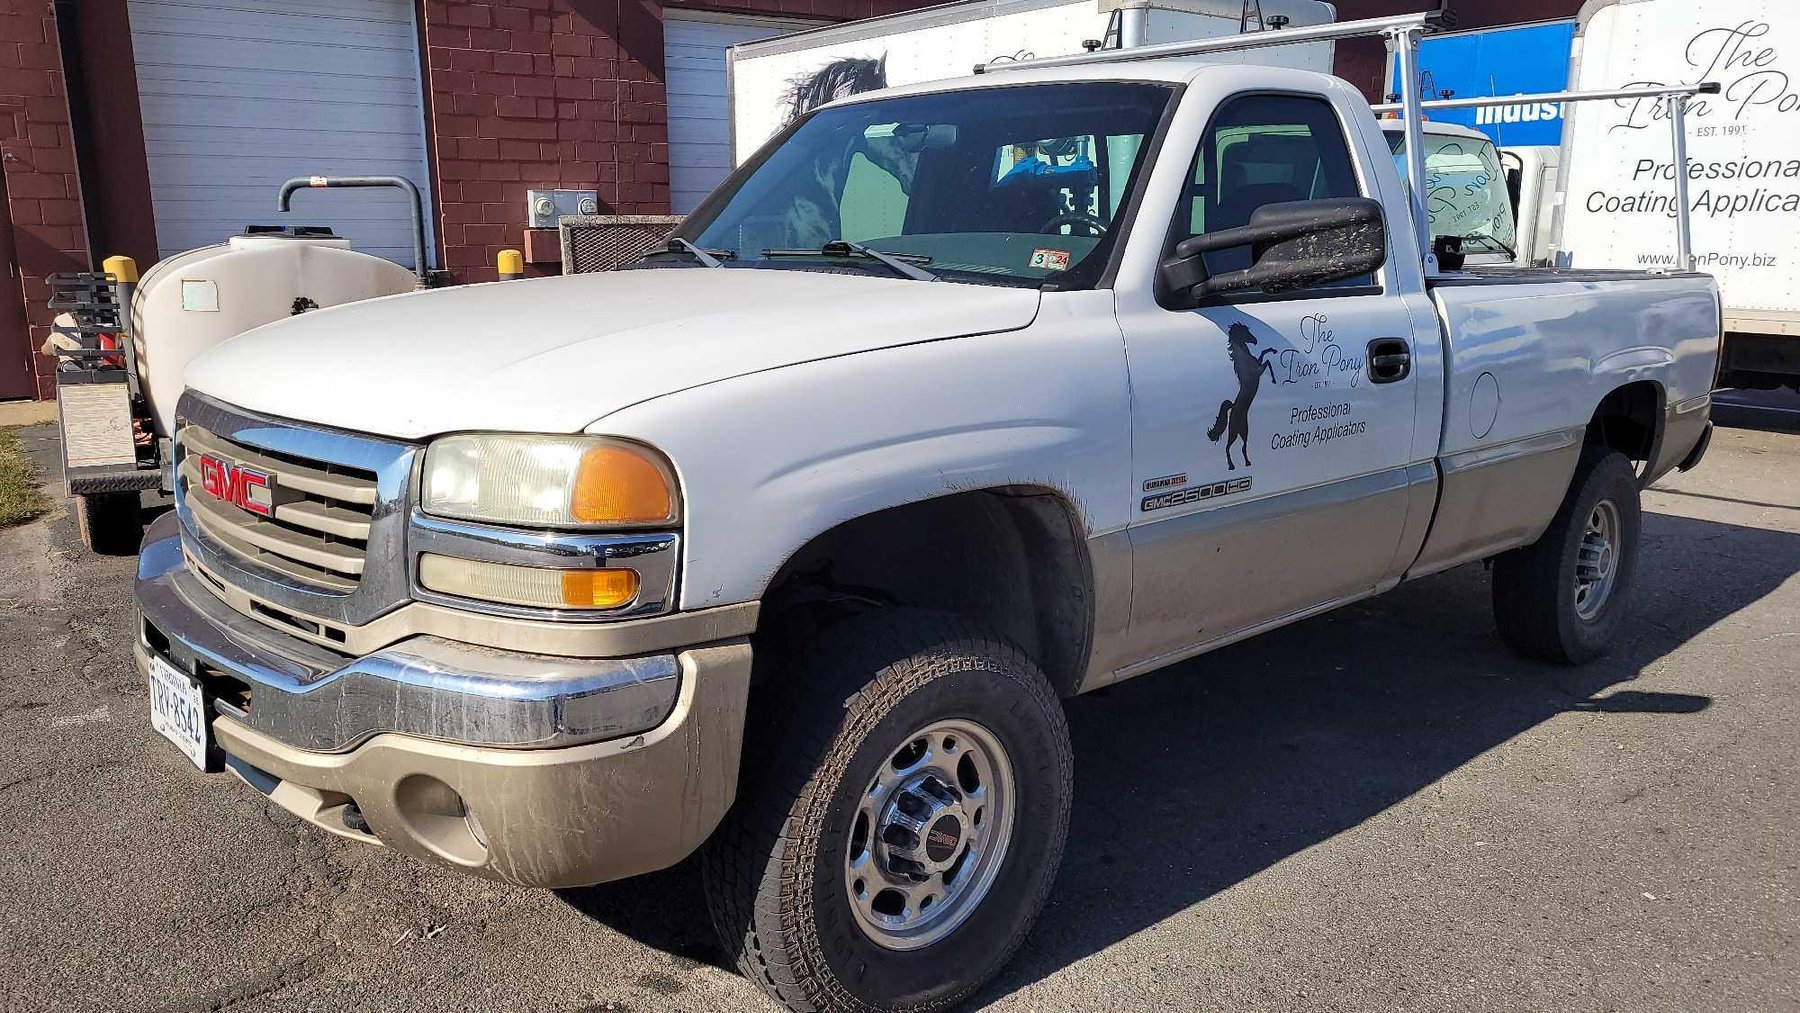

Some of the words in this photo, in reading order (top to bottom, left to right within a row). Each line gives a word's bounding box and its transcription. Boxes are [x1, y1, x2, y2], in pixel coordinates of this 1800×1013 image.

[1680, 20, 1778, 85] The
[1726, 70, 1800, 121] Po
[1696, 126, 1718, 137] EST.
[1722, 125, 1746, 136] 1991
[1034, 253, 1045, 265] 3
[1056, 255, 1068, 265] 24
[1637, 252, 1777, 270] www.nPony.biz
[1300, 312, 1335, 354] The
[1279, 349, 1319, 386] Iron
[1321, 344, 1364, 388] Pony
[1290, 399, 1351, 425] Professional
[1271, 430, 1311, 451] Coating
[1312, 420, 1367, 446] Applicators
[200, 454, 274, 518] GMC
